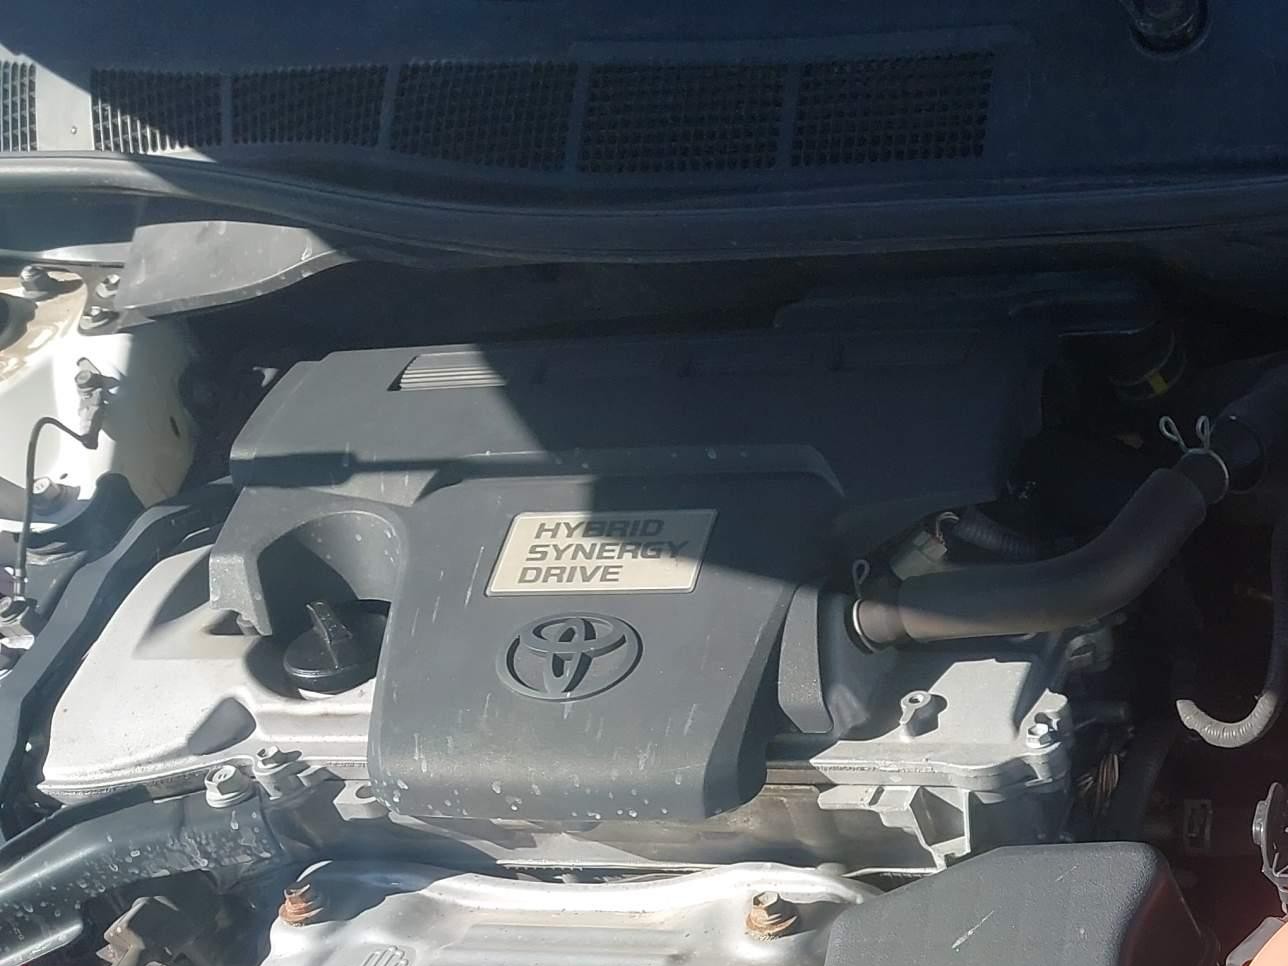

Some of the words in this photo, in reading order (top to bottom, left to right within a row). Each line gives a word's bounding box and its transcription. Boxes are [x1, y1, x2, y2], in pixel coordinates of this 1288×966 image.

[534, 519, 665, 539] HYBRID
[525, 540, 689, 562] SYNERGY
[517, 564, 624, 584] DRIVE
